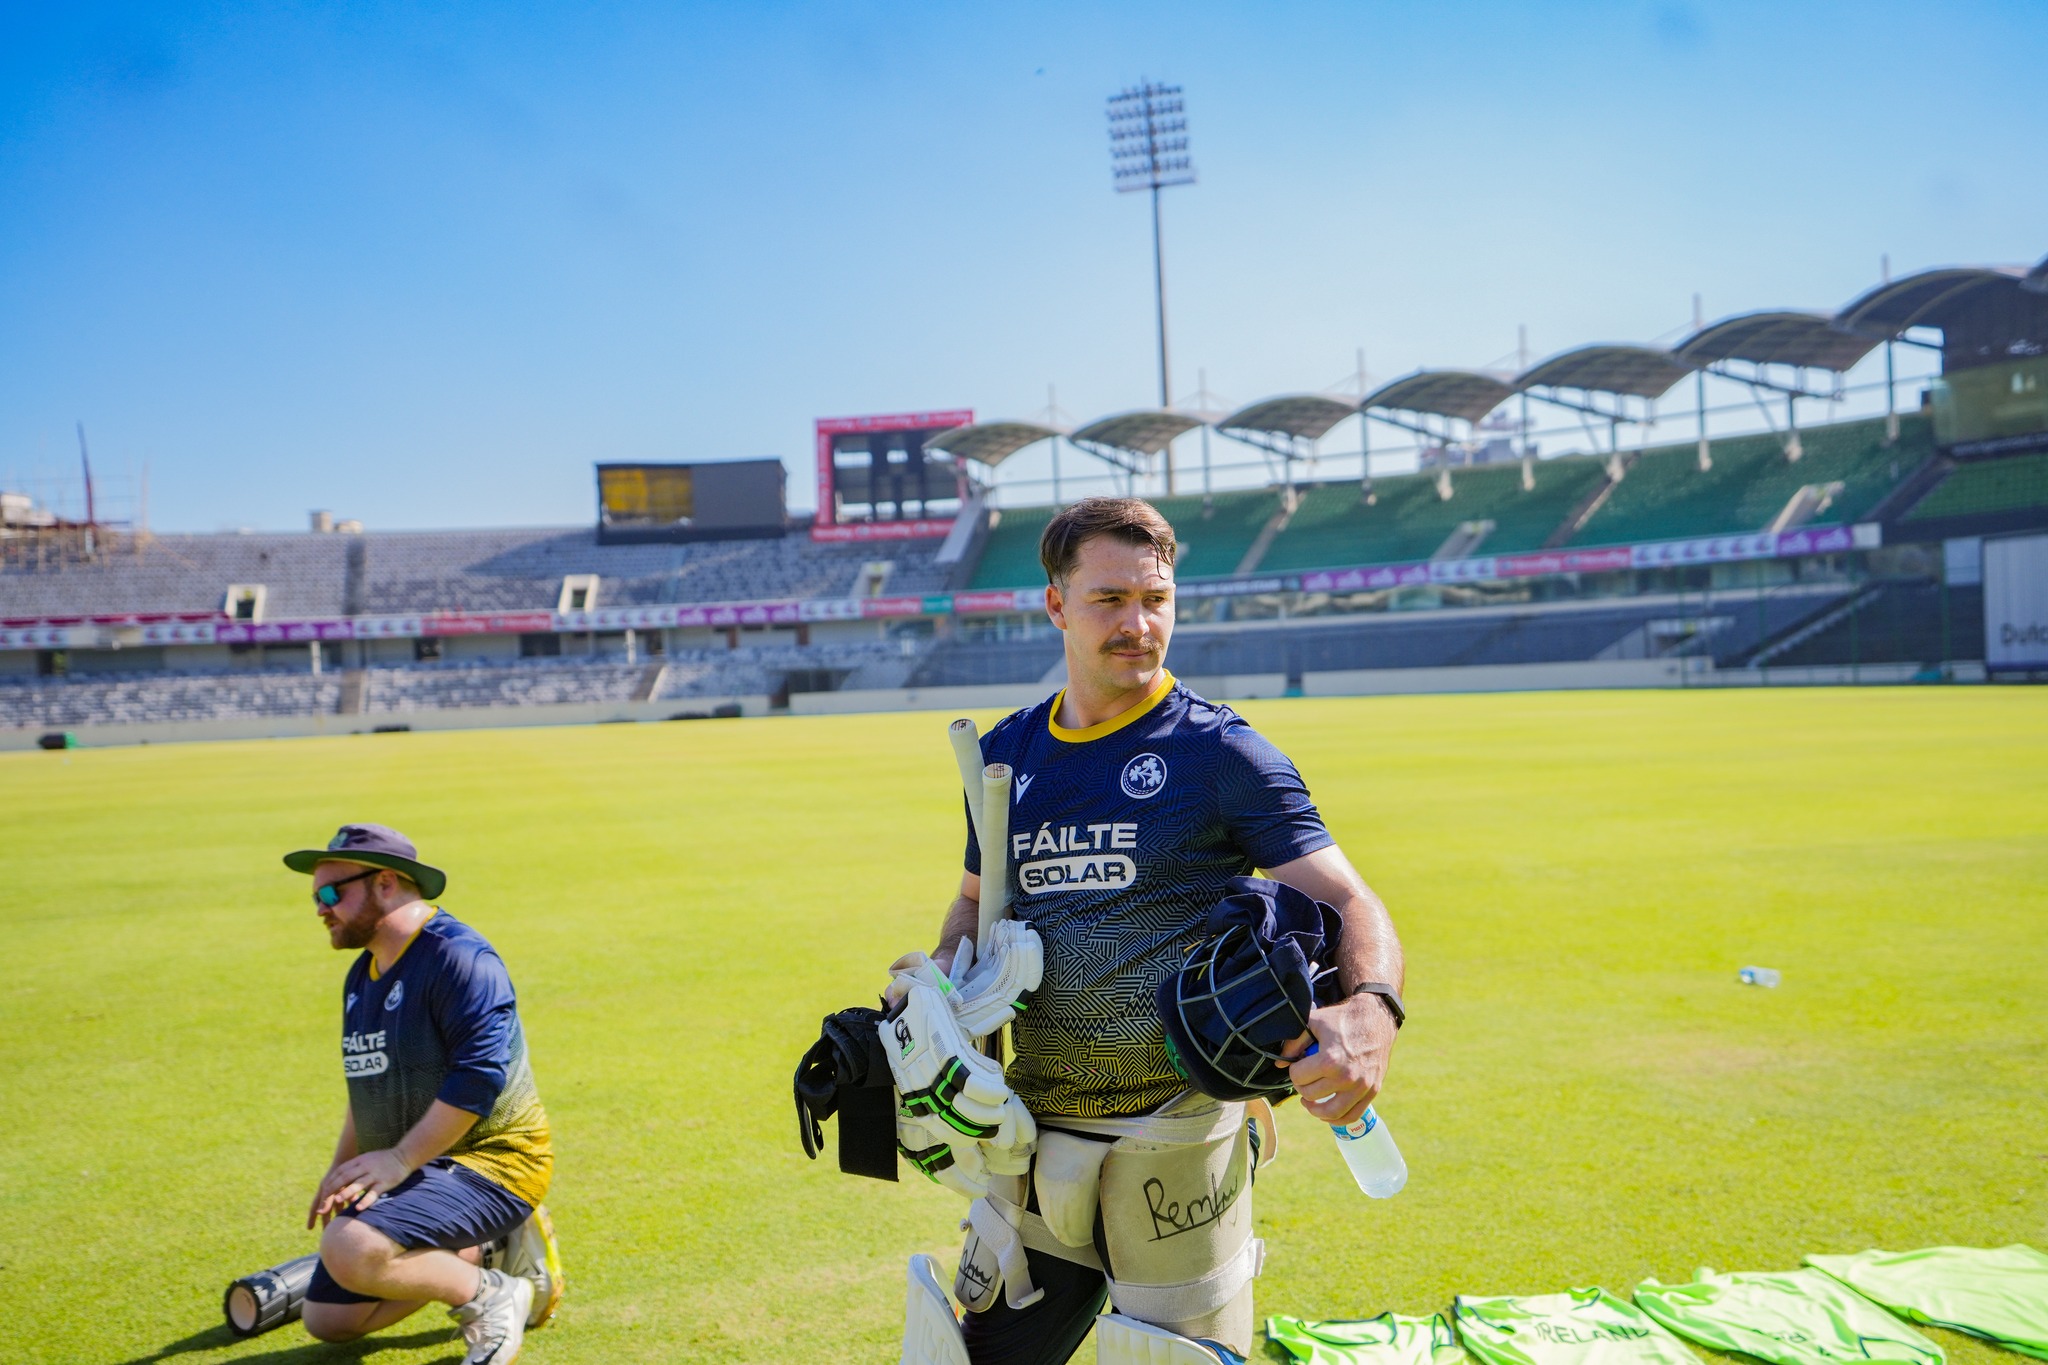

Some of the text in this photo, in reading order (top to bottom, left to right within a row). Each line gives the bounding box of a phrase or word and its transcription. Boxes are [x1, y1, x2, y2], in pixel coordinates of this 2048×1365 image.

[1012, 822, 1138, 859] FÁILTE
[1024, 861, 1127, 888] SOLAR
[342, 1030, 387, 1053] FÁLTE
